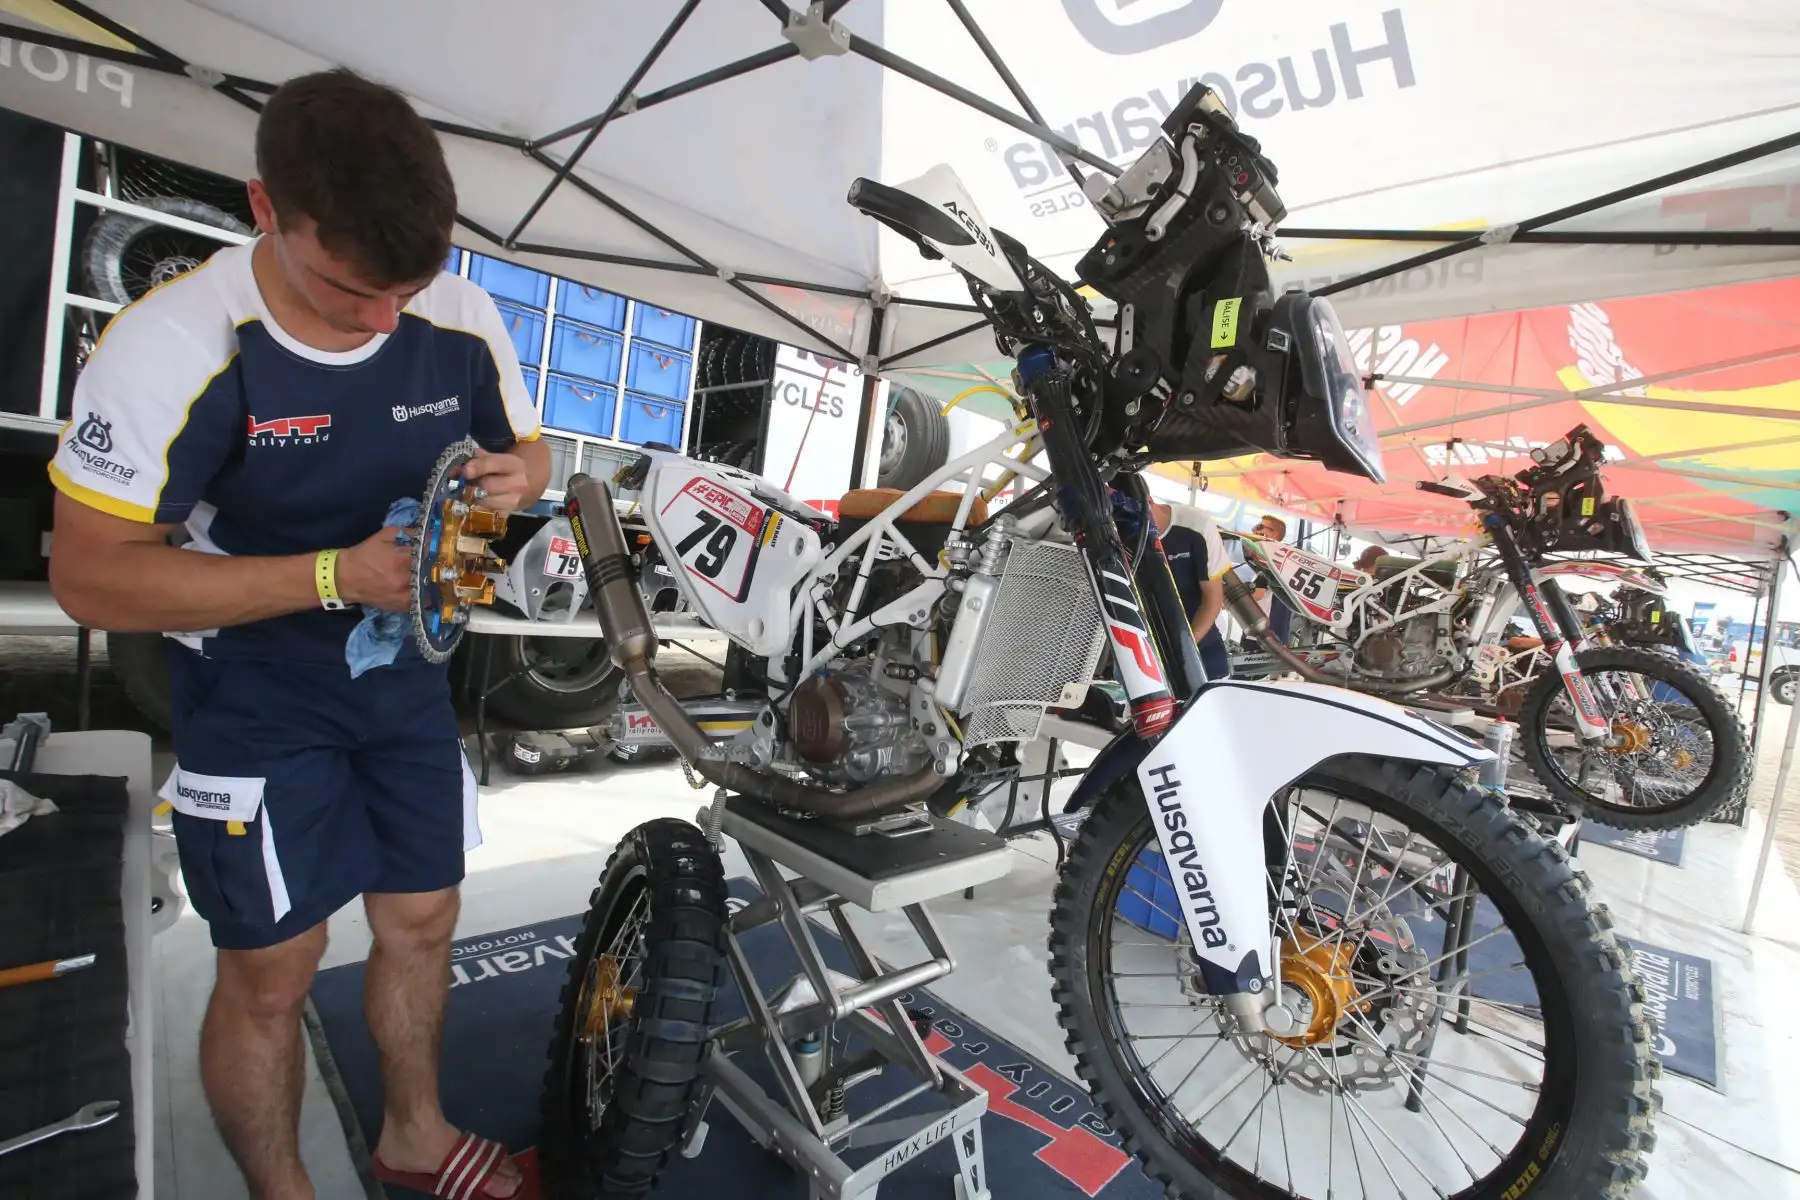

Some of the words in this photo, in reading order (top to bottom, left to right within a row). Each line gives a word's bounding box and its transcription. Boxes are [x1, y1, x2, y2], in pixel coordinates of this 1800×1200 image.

[1221, 301, 1234, 328] BALISE
[249, 437, 286, 447] ally
[294, 433, 329, 445] raid
[675, 509, 737, 579] 79
[557, 554, 580, 576] 79
[1289, 567, 1326, 599] 55
[1148, 764, 1228, 948] Husqvarna
[884, 1138, 921, 1172] HMX
[926, 1114, 958, 1146] LIFT
